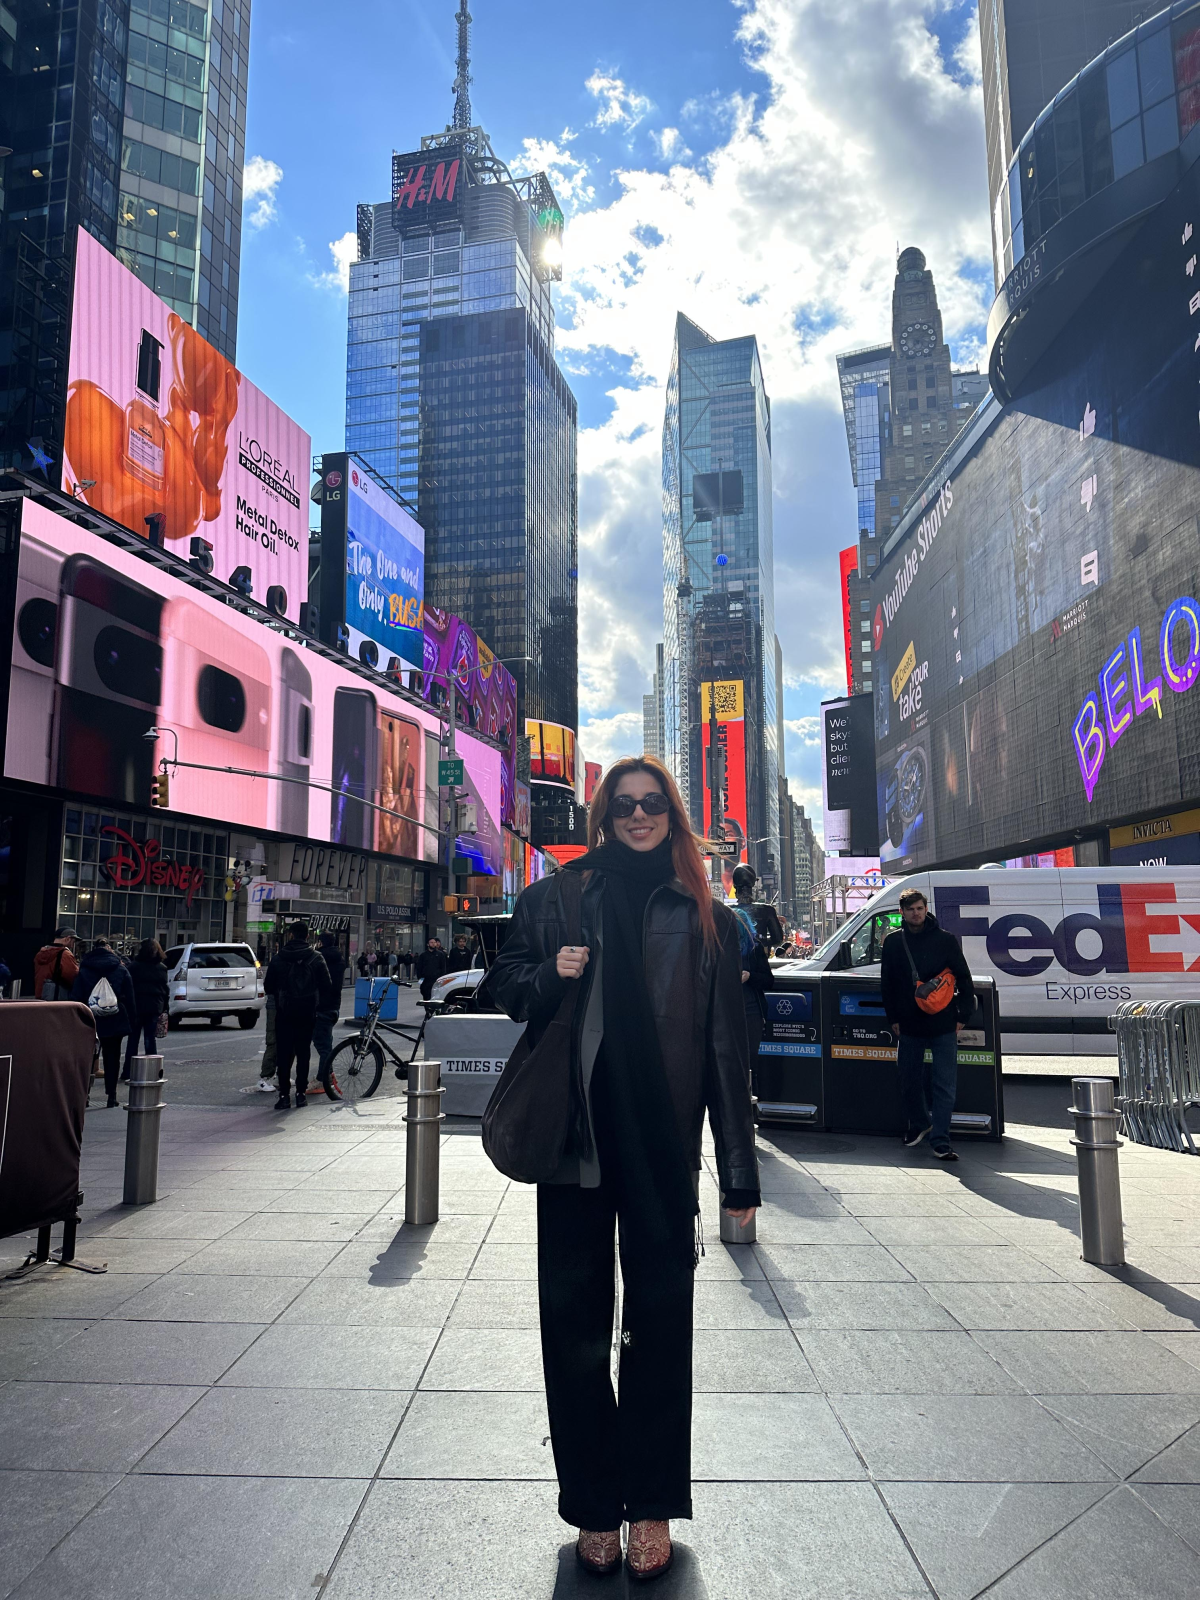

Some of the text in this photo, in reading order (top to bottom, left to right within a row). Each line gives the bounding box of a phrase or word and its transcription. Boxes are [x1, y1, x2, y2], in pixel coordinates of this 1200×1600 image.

[396, 158, 460, 209] H&M
[239, 431, 301, 496] L'ORÉAL
[240, 455, 299, 508] PROFESSIONNEL
[359, 477, 369, 495] LG
[261, 485, 280, 503] PARIS
[326, 491, 341, 501] LG
[236, 494, 300, 553] Metal Detox
[236, 514, 279, 557] Hair Oil.
[882, 547, 919, 628] YouTube
[917, 479, 954, 562] Shorts
[349, 541, 420, 592] The One and
[358, 580, 388, 627] Only,
[1062, 599, 1089, 622] MARRIOTT
[1063, 611, 1086, 633] MARQUIS
[899, 682, 922, 722] take
[830, 742, 848, 753] but
[830, 754, 850, 765] clie
[1133, 819, 1173, 840] INVICTA
[290, 844, 366, 889] FOREVER
[309, 914, 350, 930] FOREVER 21
[386, 906, 399, 915] POLO
[934, 883, 1200, 977] FedE
[1045, 981, 1132, 1004] Express
[783, 1046, 816, 1054] SQUARE
[833, 1048, 898, 1058] TIMES SQUAR
[446, 1060, 491, 1073] TIMES
